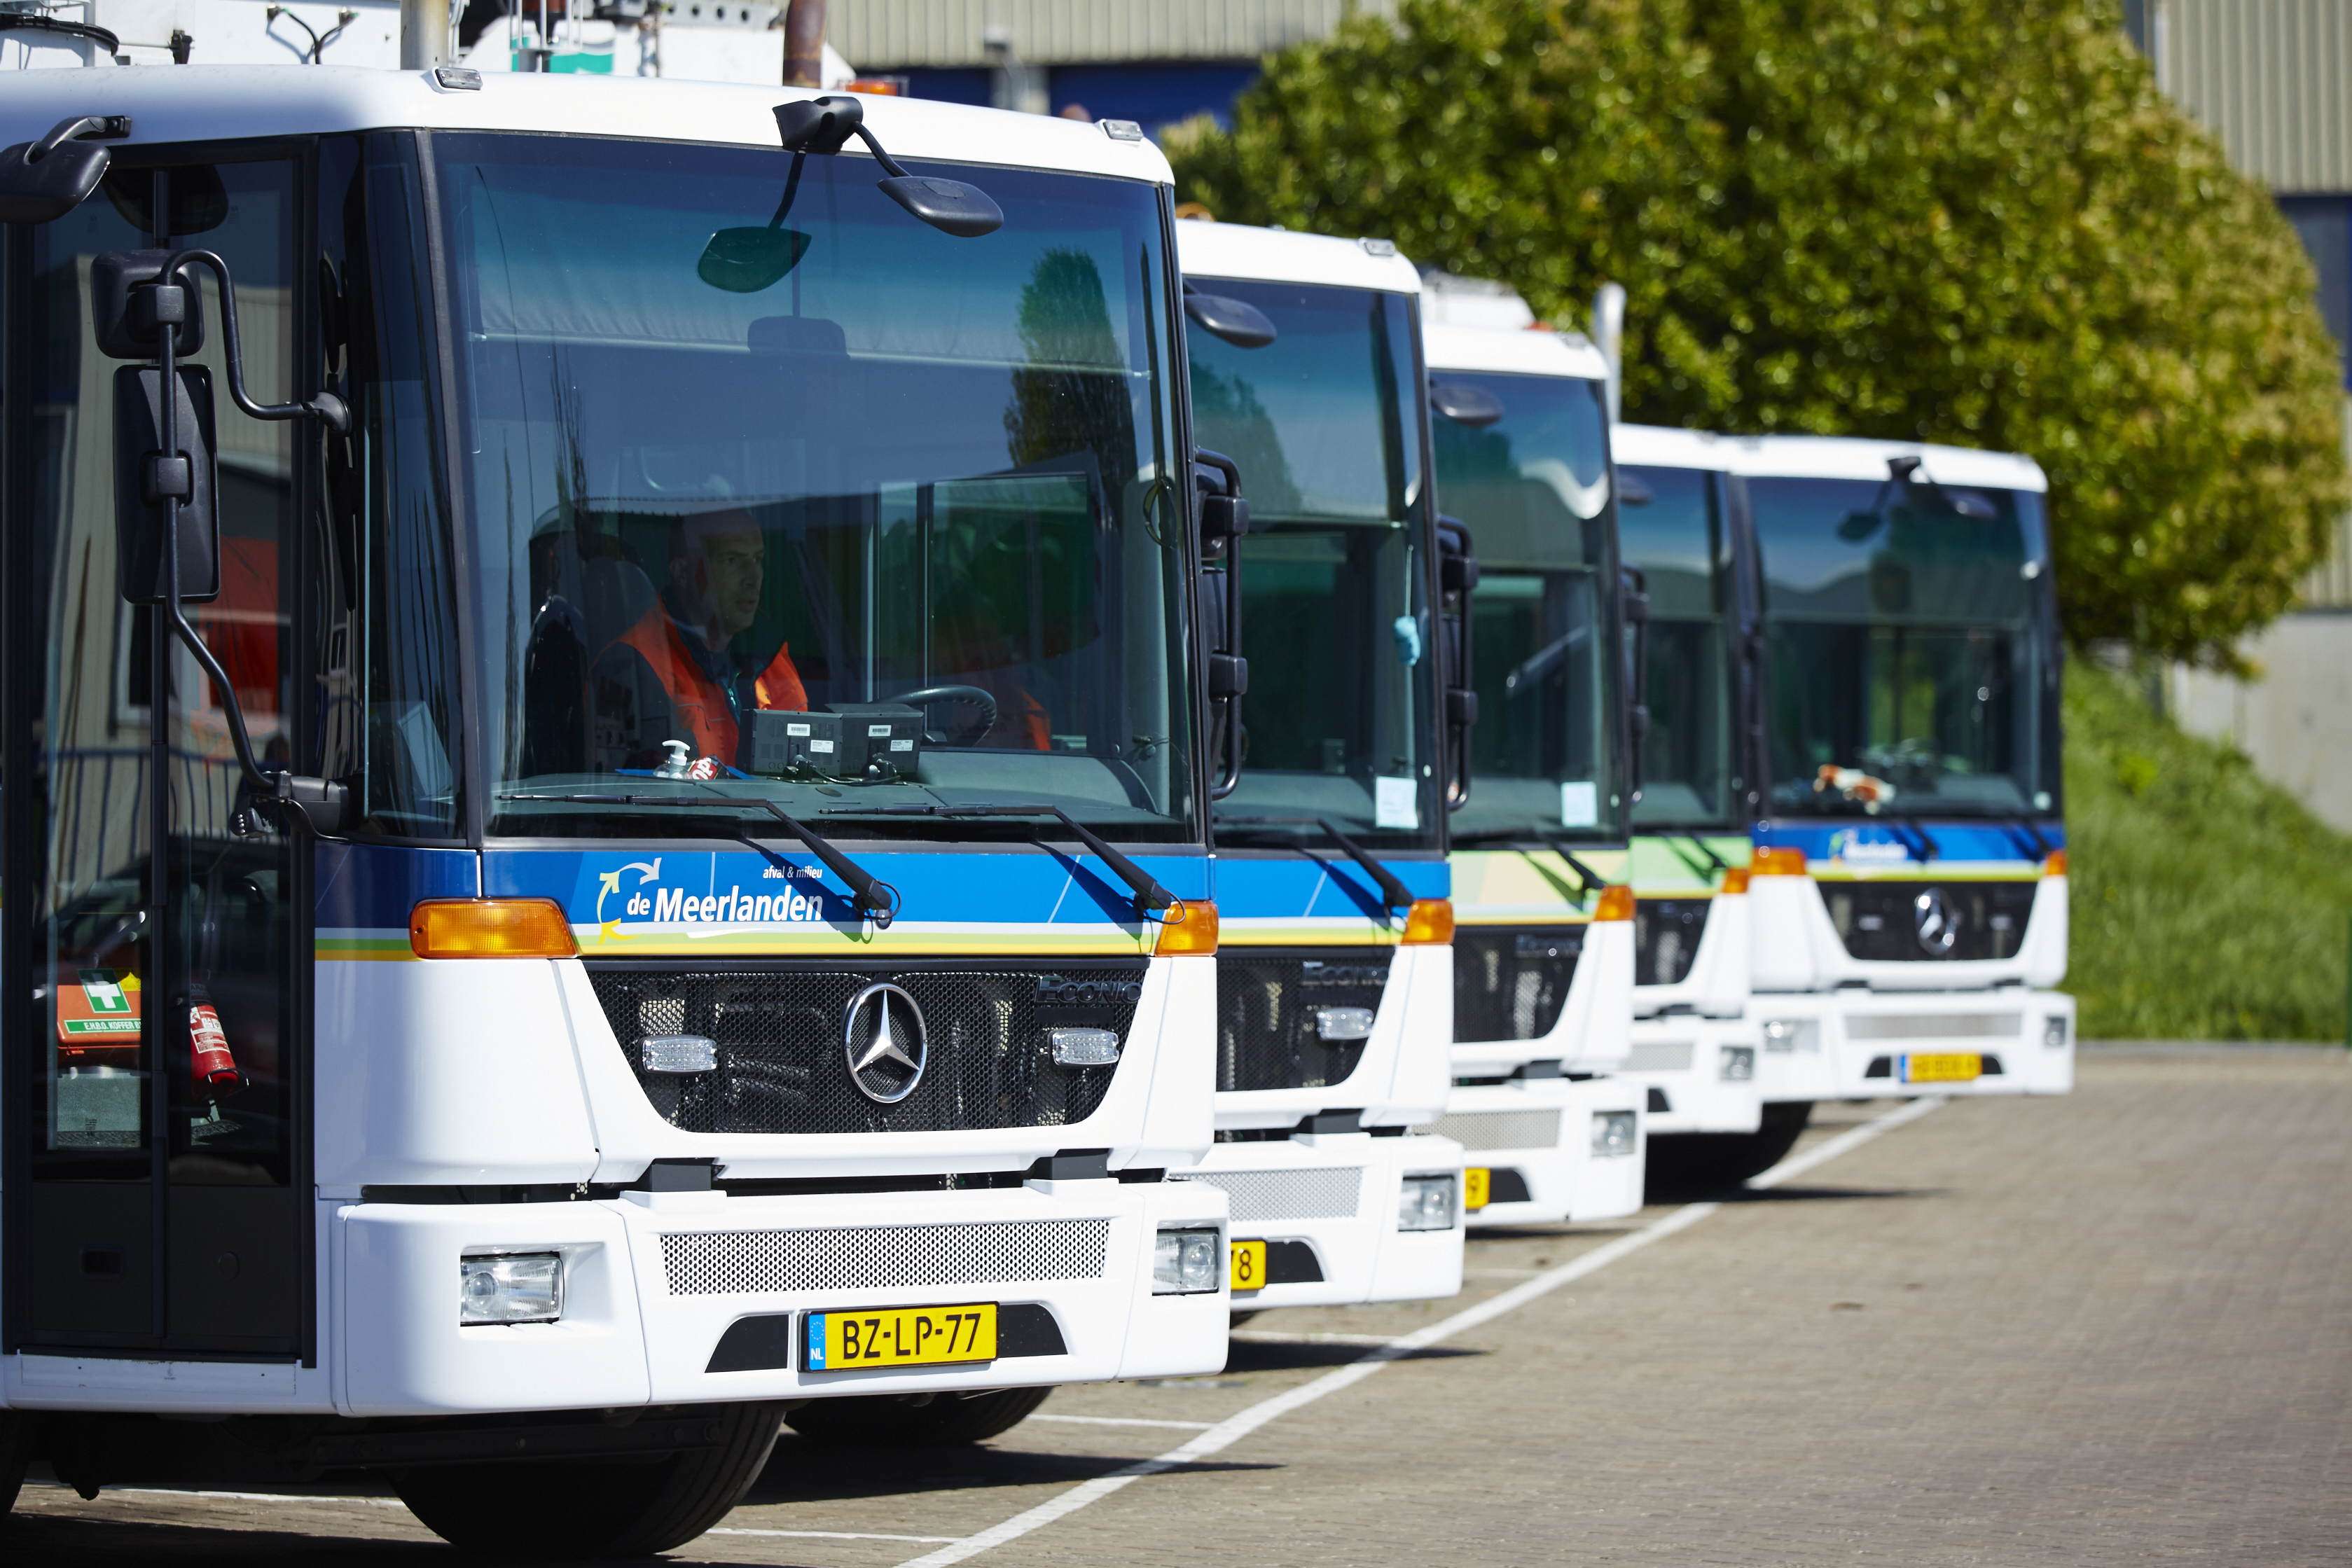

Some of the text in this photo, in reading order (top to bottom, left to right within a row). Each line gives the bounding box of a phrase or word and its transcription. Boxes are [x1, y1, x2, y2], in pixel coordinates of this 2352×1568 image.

[763, 865, 823, 879] afval & milieu
[627, 884, 824, 922] de Meerlanden
[108, 1021, 134, 1029] KOFFER
[843, 1313, 981, 1359] BZ-LP-77
[810, 1347, 824, 1361] NL
